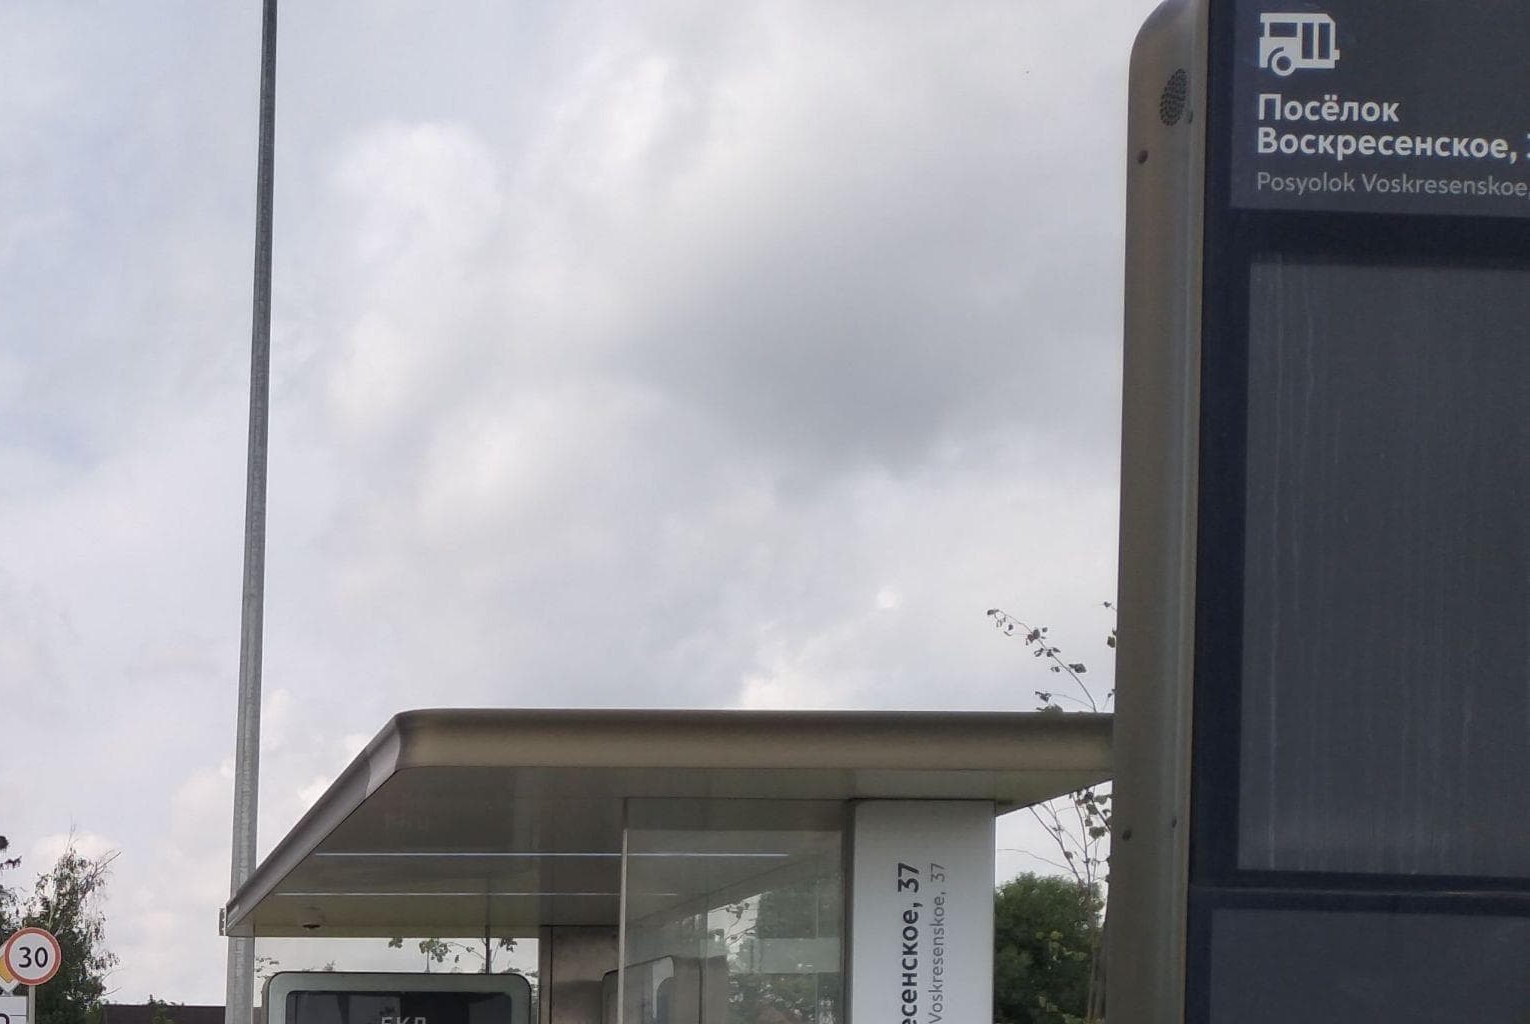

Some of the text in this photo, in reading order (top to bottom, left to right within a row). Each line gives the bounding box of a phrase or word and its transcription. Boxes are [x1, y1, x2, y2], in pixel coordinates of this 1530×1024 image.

[1257, 93, 1400, 122] Посёлок
[1256, 126, 1518, 165] Воскресенское,
[1256, 171, 1356, 196] Posyolok
[897, 862, 920, 893] 37
[930, 862, 946, 883] 37
[18, 946, 49, 968] 30
[927, 891, 946, 1024] Voskresenskoe,
